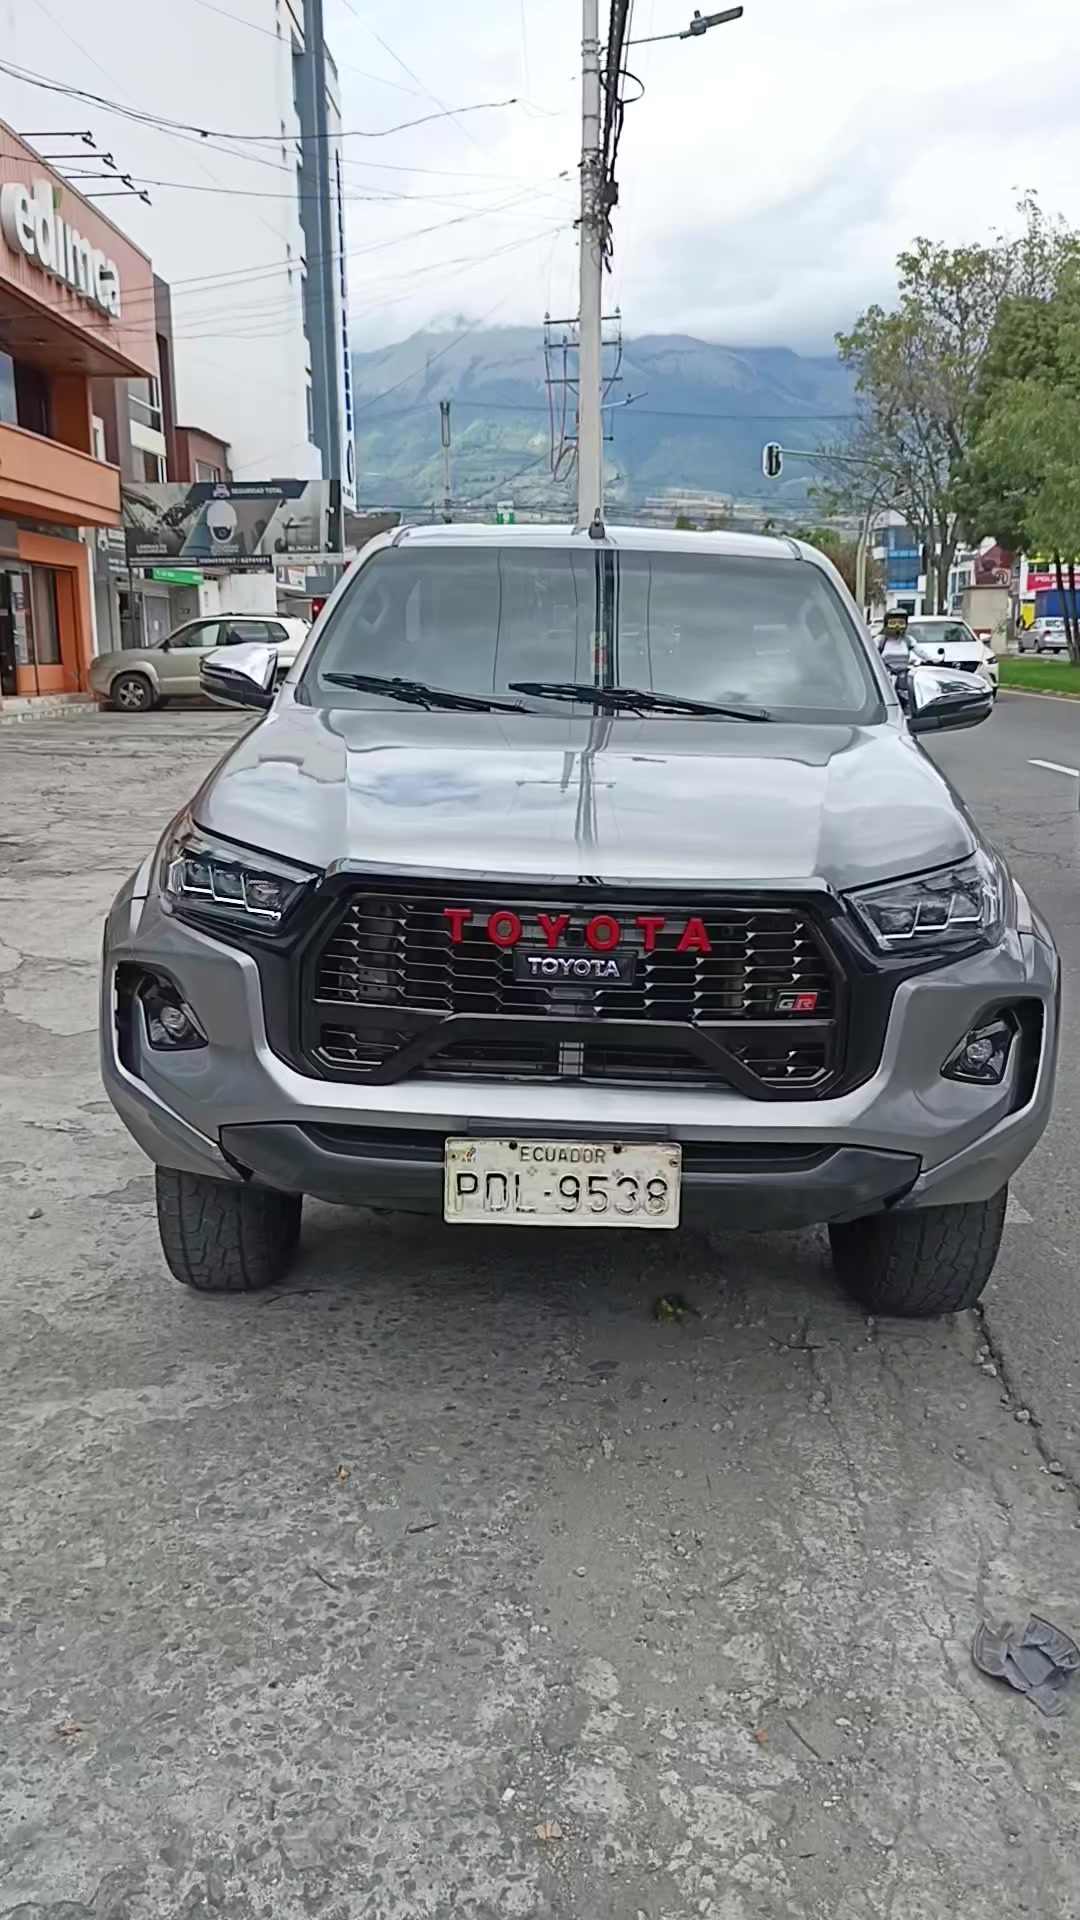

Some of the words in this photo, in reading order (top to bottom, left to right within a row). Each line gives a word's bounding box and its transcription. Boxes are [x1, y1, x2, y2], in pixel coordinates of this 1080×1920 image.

[1, 179, 121, 319] edimca
[443, 907, 712, 953] TOYOTA
[527, 957, 620, 977] TOYOTA
[778, 998, 813, 1009] GR
[519, 1146, 606, 1163] ECUADOR
[455, 1170, 669, 1216] PDL-9538
